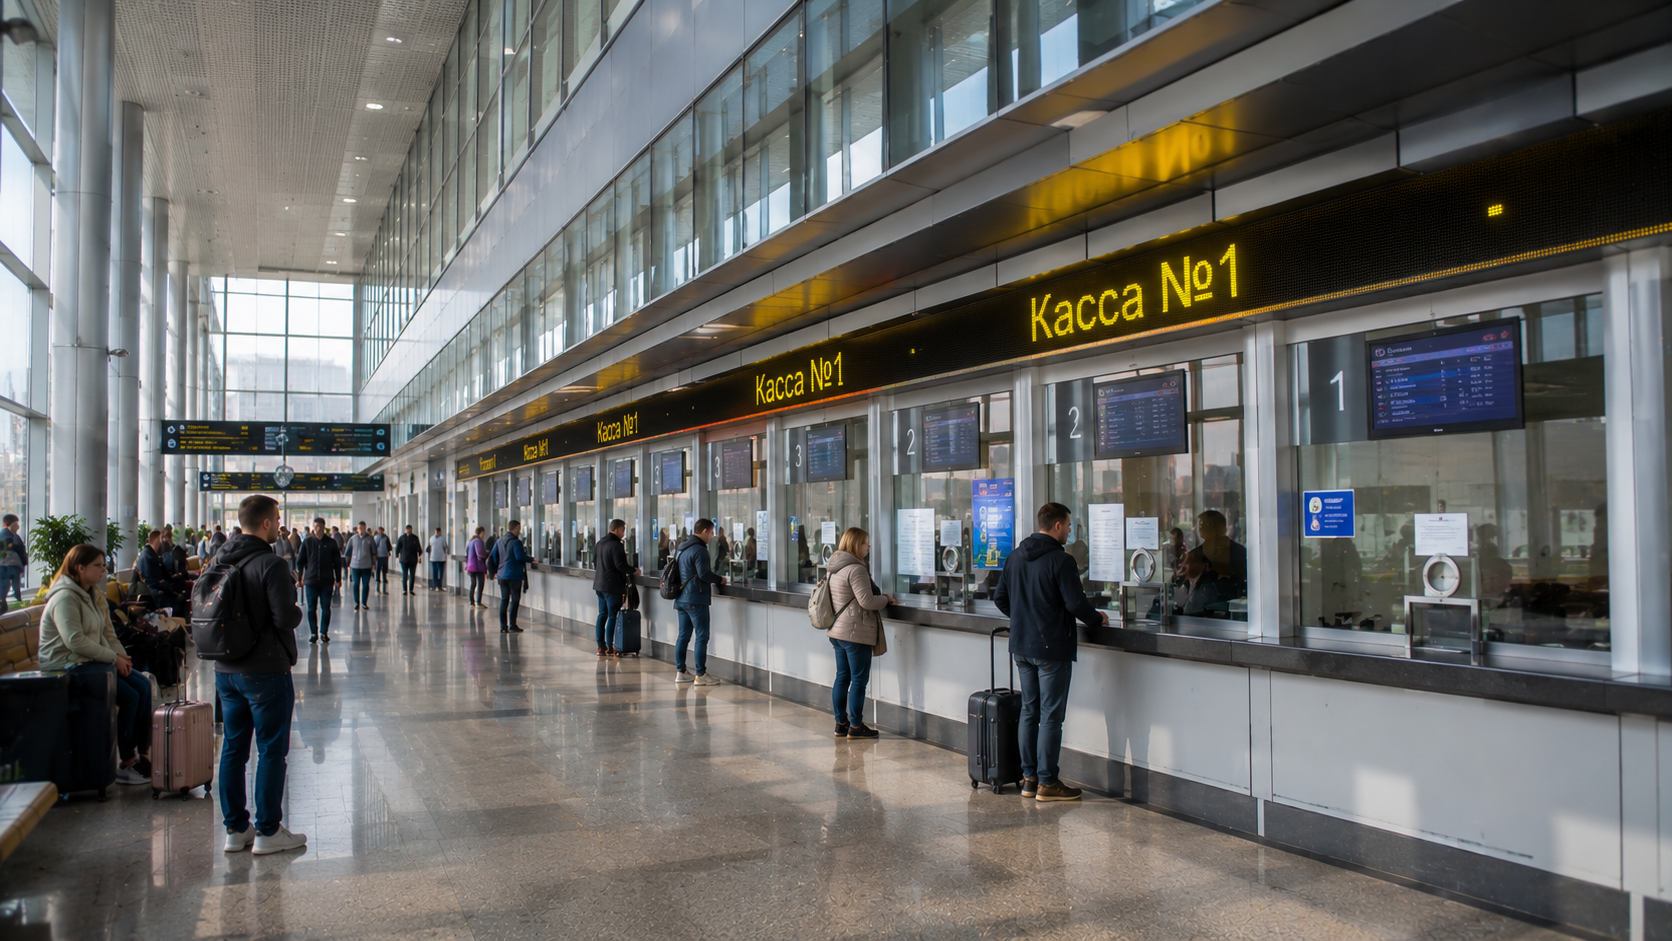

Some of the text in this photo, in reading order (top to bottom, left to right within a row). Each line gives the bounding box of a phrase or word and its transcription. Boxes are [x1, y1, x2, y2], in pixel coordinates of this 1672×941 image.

[1031, 293, 1145, 343] Касса
[756, 373, 805, 406] Касса
[1330, 370, 1345, 411] 1
[1068, 406, 1082, 439] 2
[795, 444, 802, 467] 3
[906, 428, 916, 455] 2
